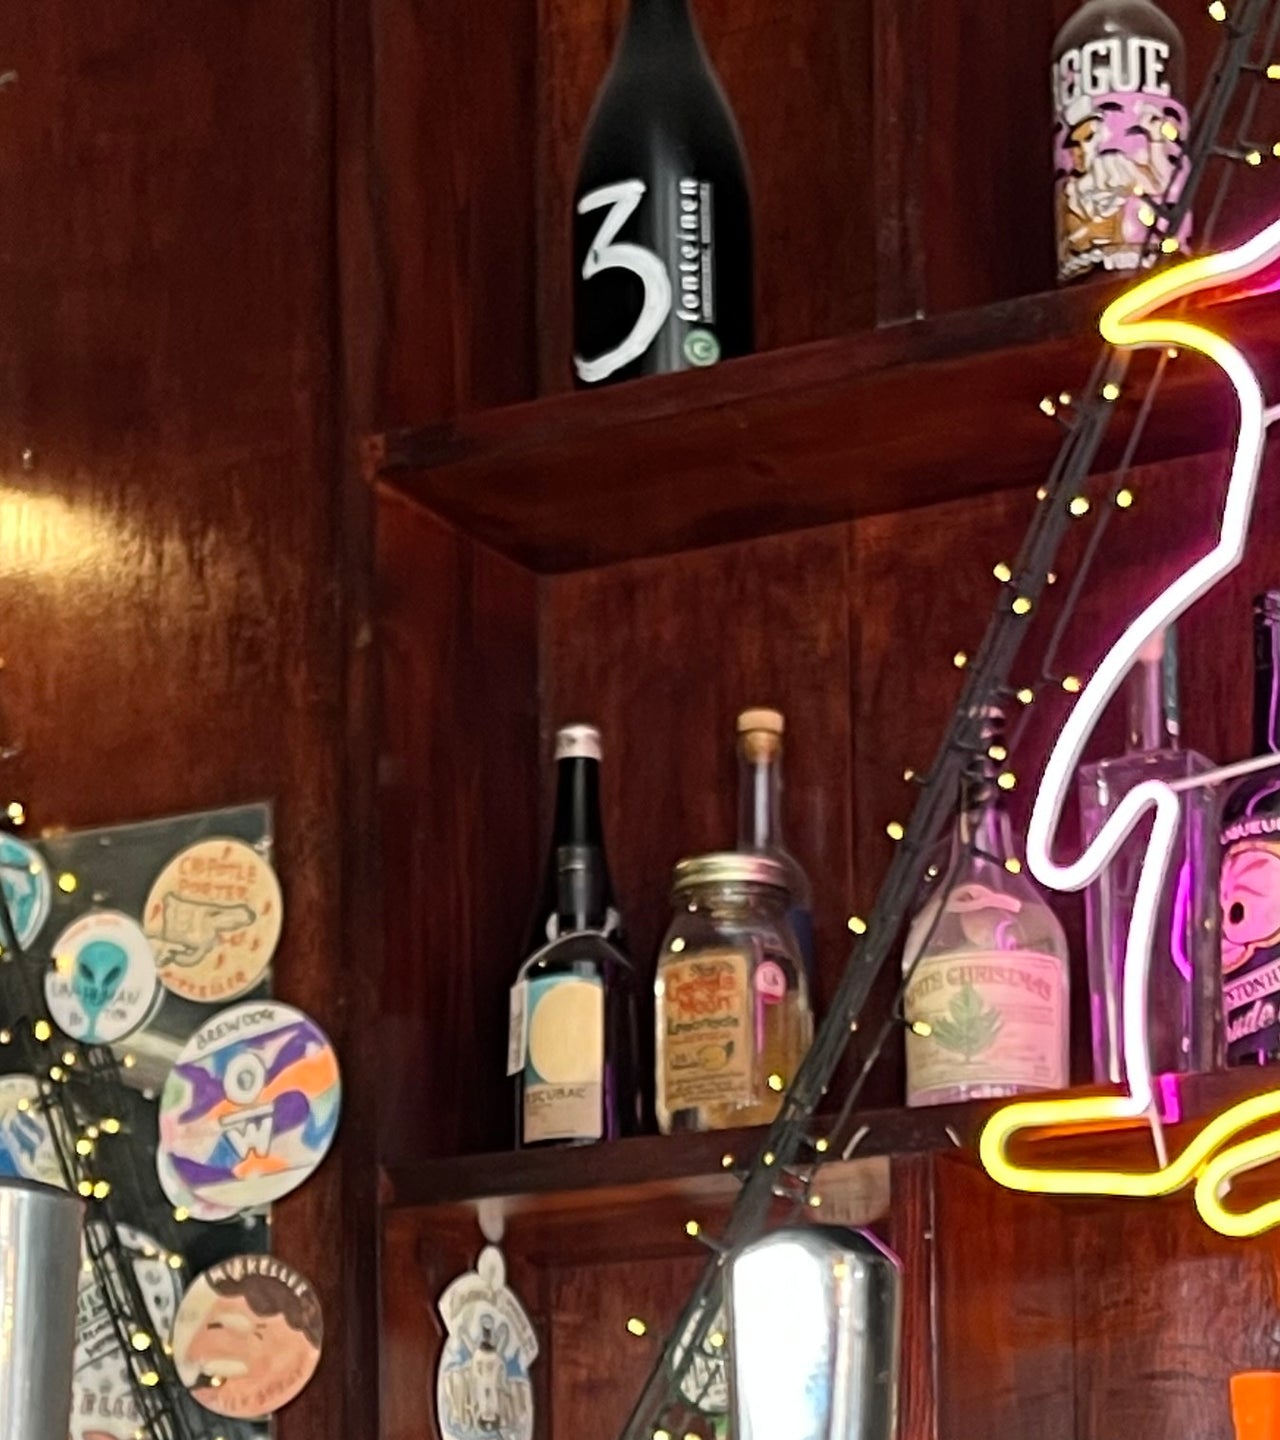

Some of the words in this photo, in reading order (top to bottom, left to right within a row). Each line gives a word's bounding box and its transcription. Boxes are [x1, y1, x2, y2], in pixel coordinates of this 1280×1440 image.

[574, 178, 672, 383] 3
[676, 178, 700, 322] fonteinen
[196, 1007, 277, 1050] BREWDOG
